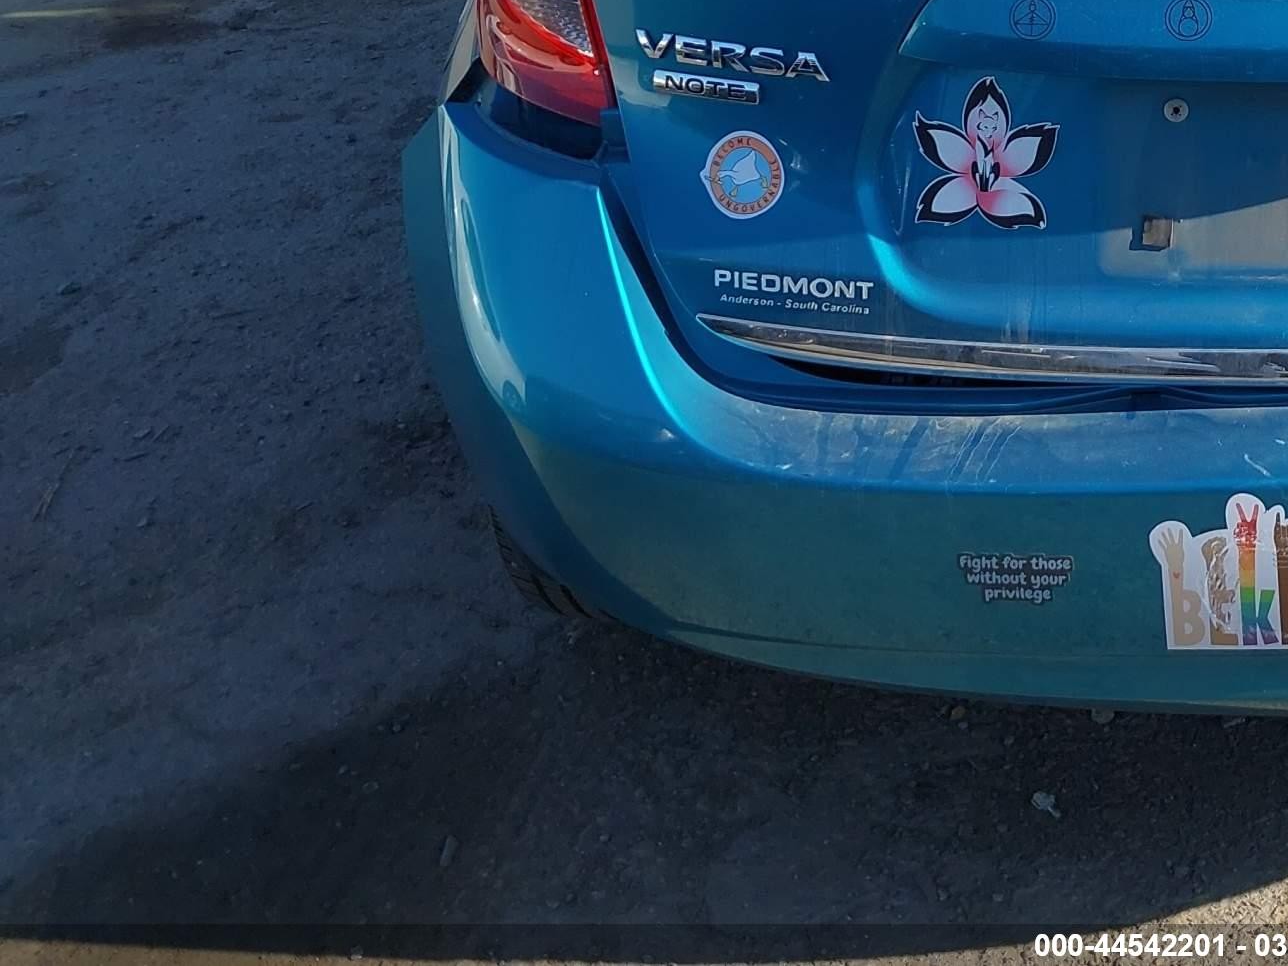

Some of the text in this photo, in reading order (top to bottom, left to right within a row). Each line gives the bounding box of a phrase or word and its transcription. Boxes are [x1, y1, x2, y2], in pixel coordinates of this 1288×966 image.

[635, 29, 830, 82] VERSA
[665, 74, 747, 101] NOTE
[714, 269, 874, 300] PIEDMONT
[720, 294, 774, 307] Anderson
[785, 299, 818, 311] South
[821, 302, 870, 315] Carolina
[1002, 555, 1027, 569] for
[1030, 557, 1071, 570] those
[967, 571, 1067, 589] without your
[984, 587, 1051, 603] privilege
